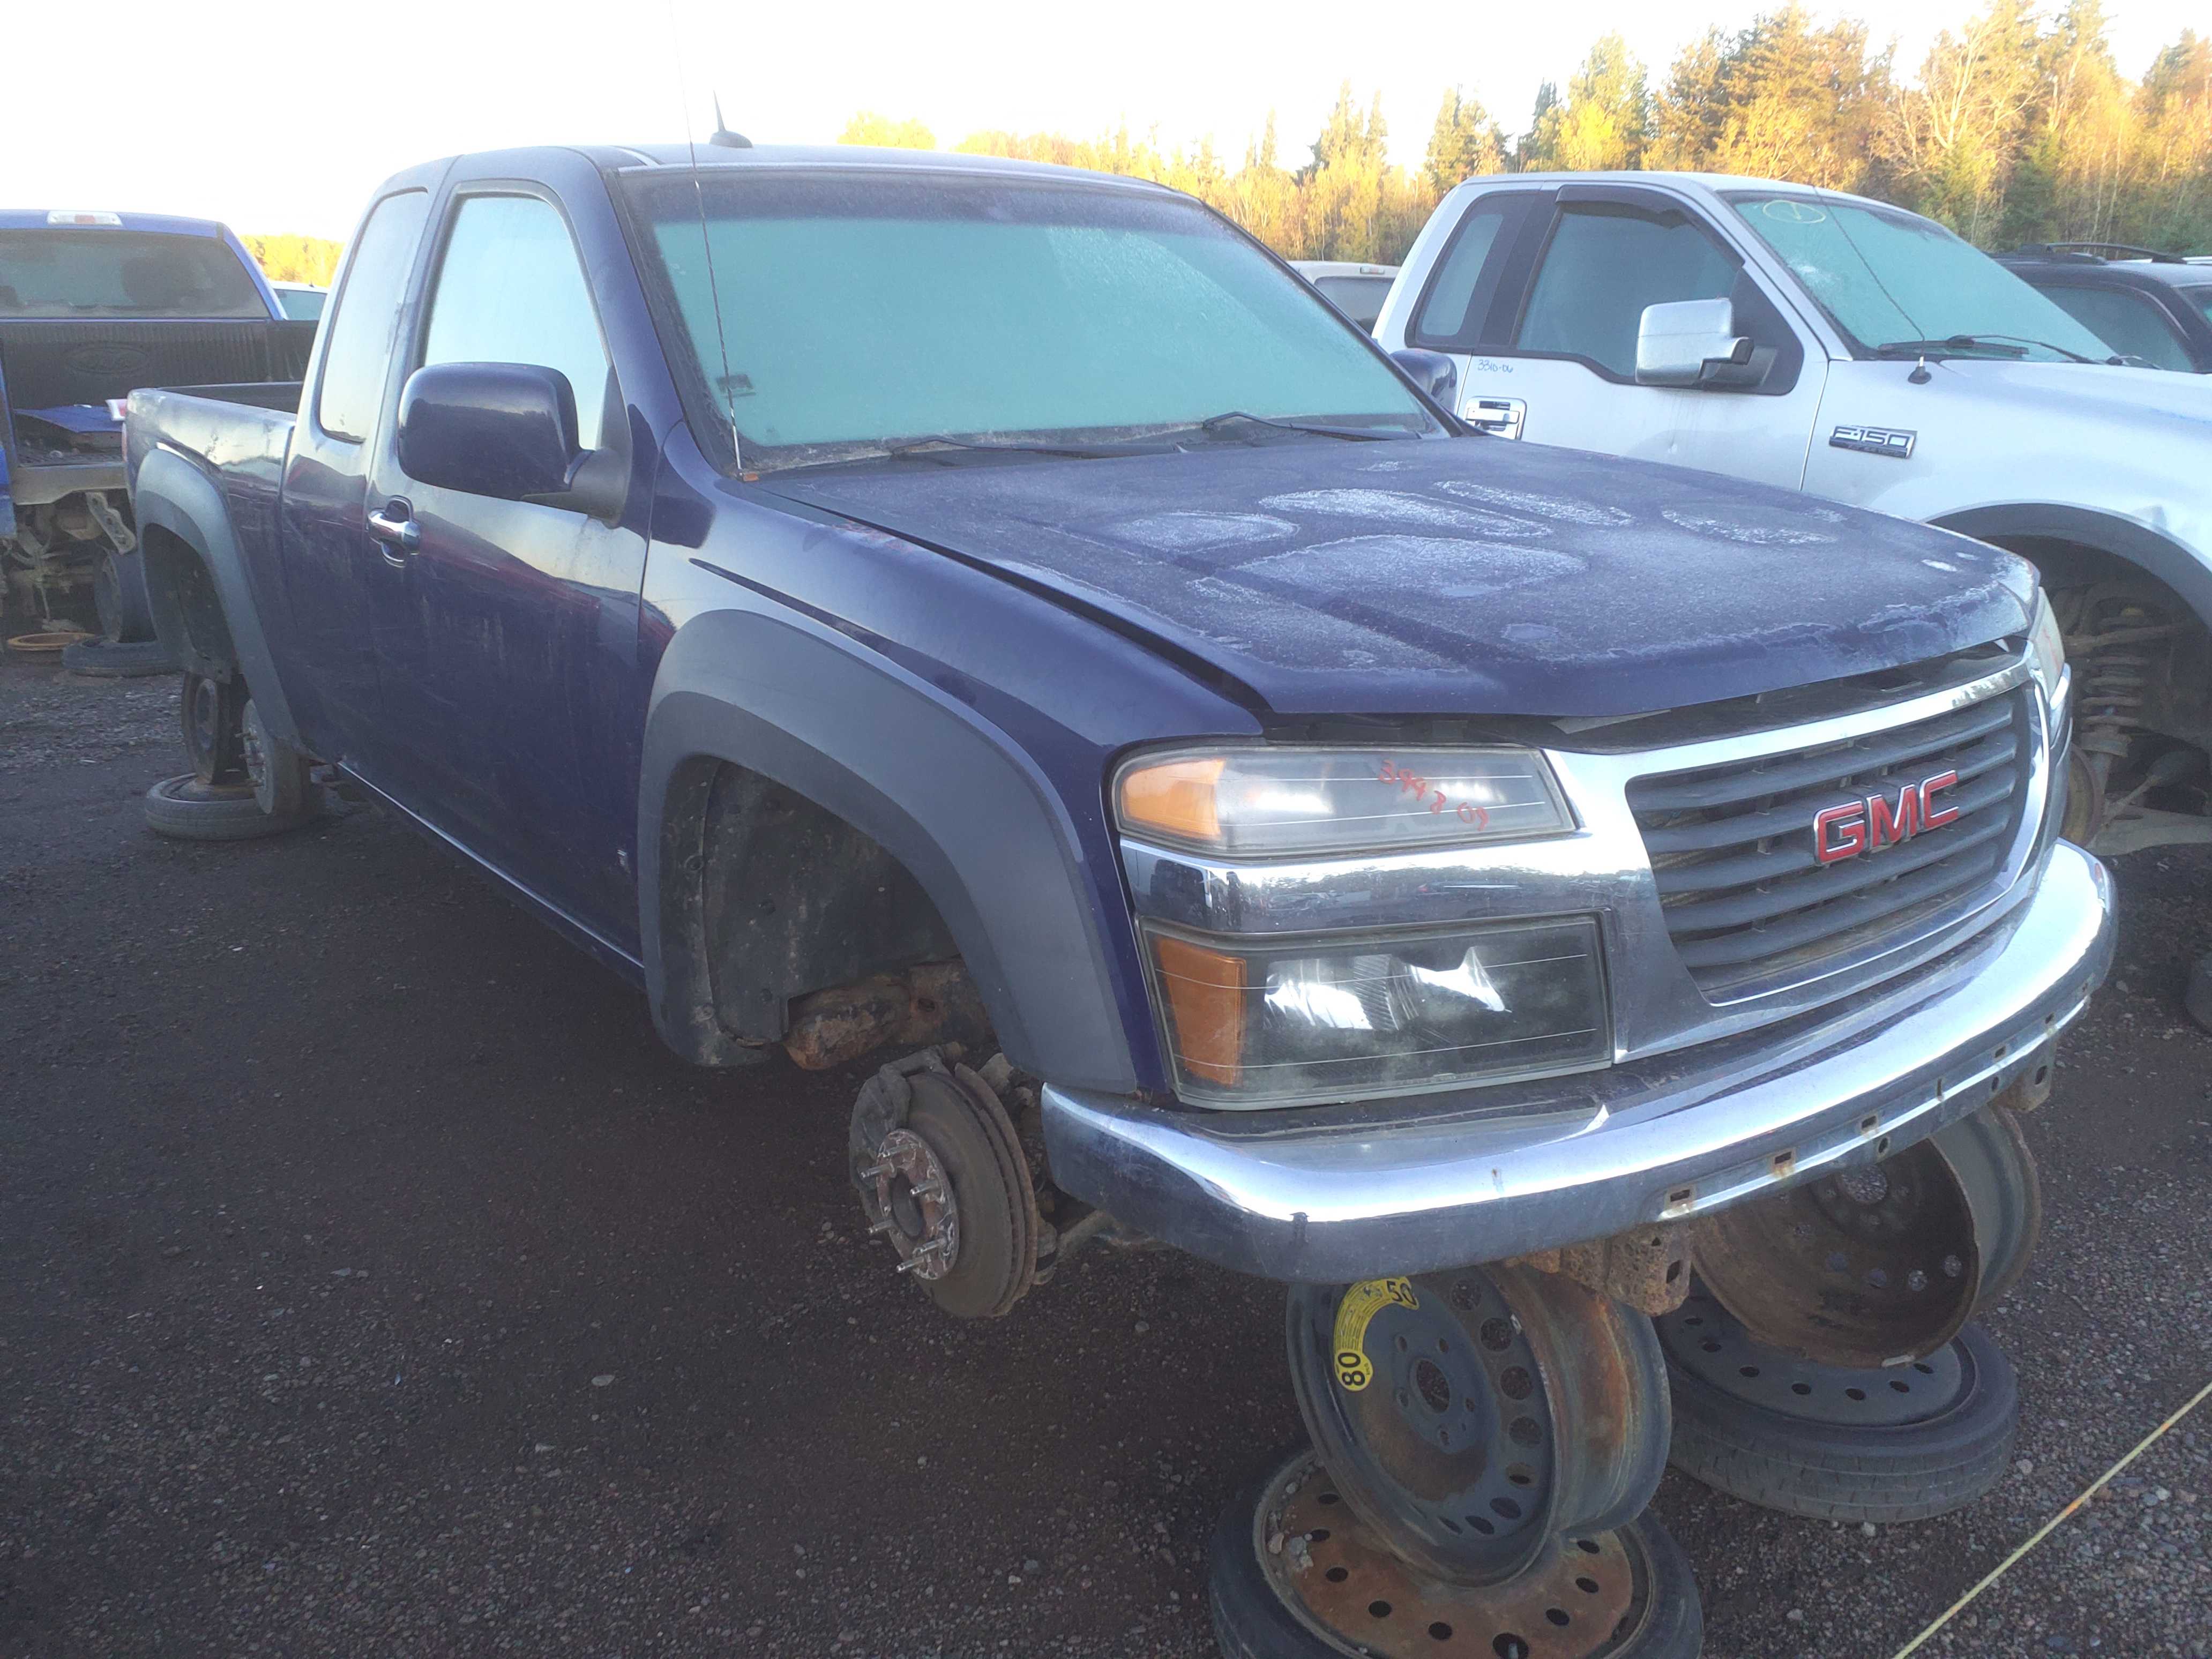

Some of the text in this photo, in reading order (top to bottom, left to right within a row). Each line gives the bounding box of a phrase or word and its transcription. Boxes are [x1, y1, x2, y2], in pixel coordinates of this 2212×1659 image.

[1833, 425, 1911, 449] F-150
[1813, 769, 1959, 864] GMC
[1386, 1280, 1417, 1306] 50
[1337, 1352, 1366, 1386] 80
